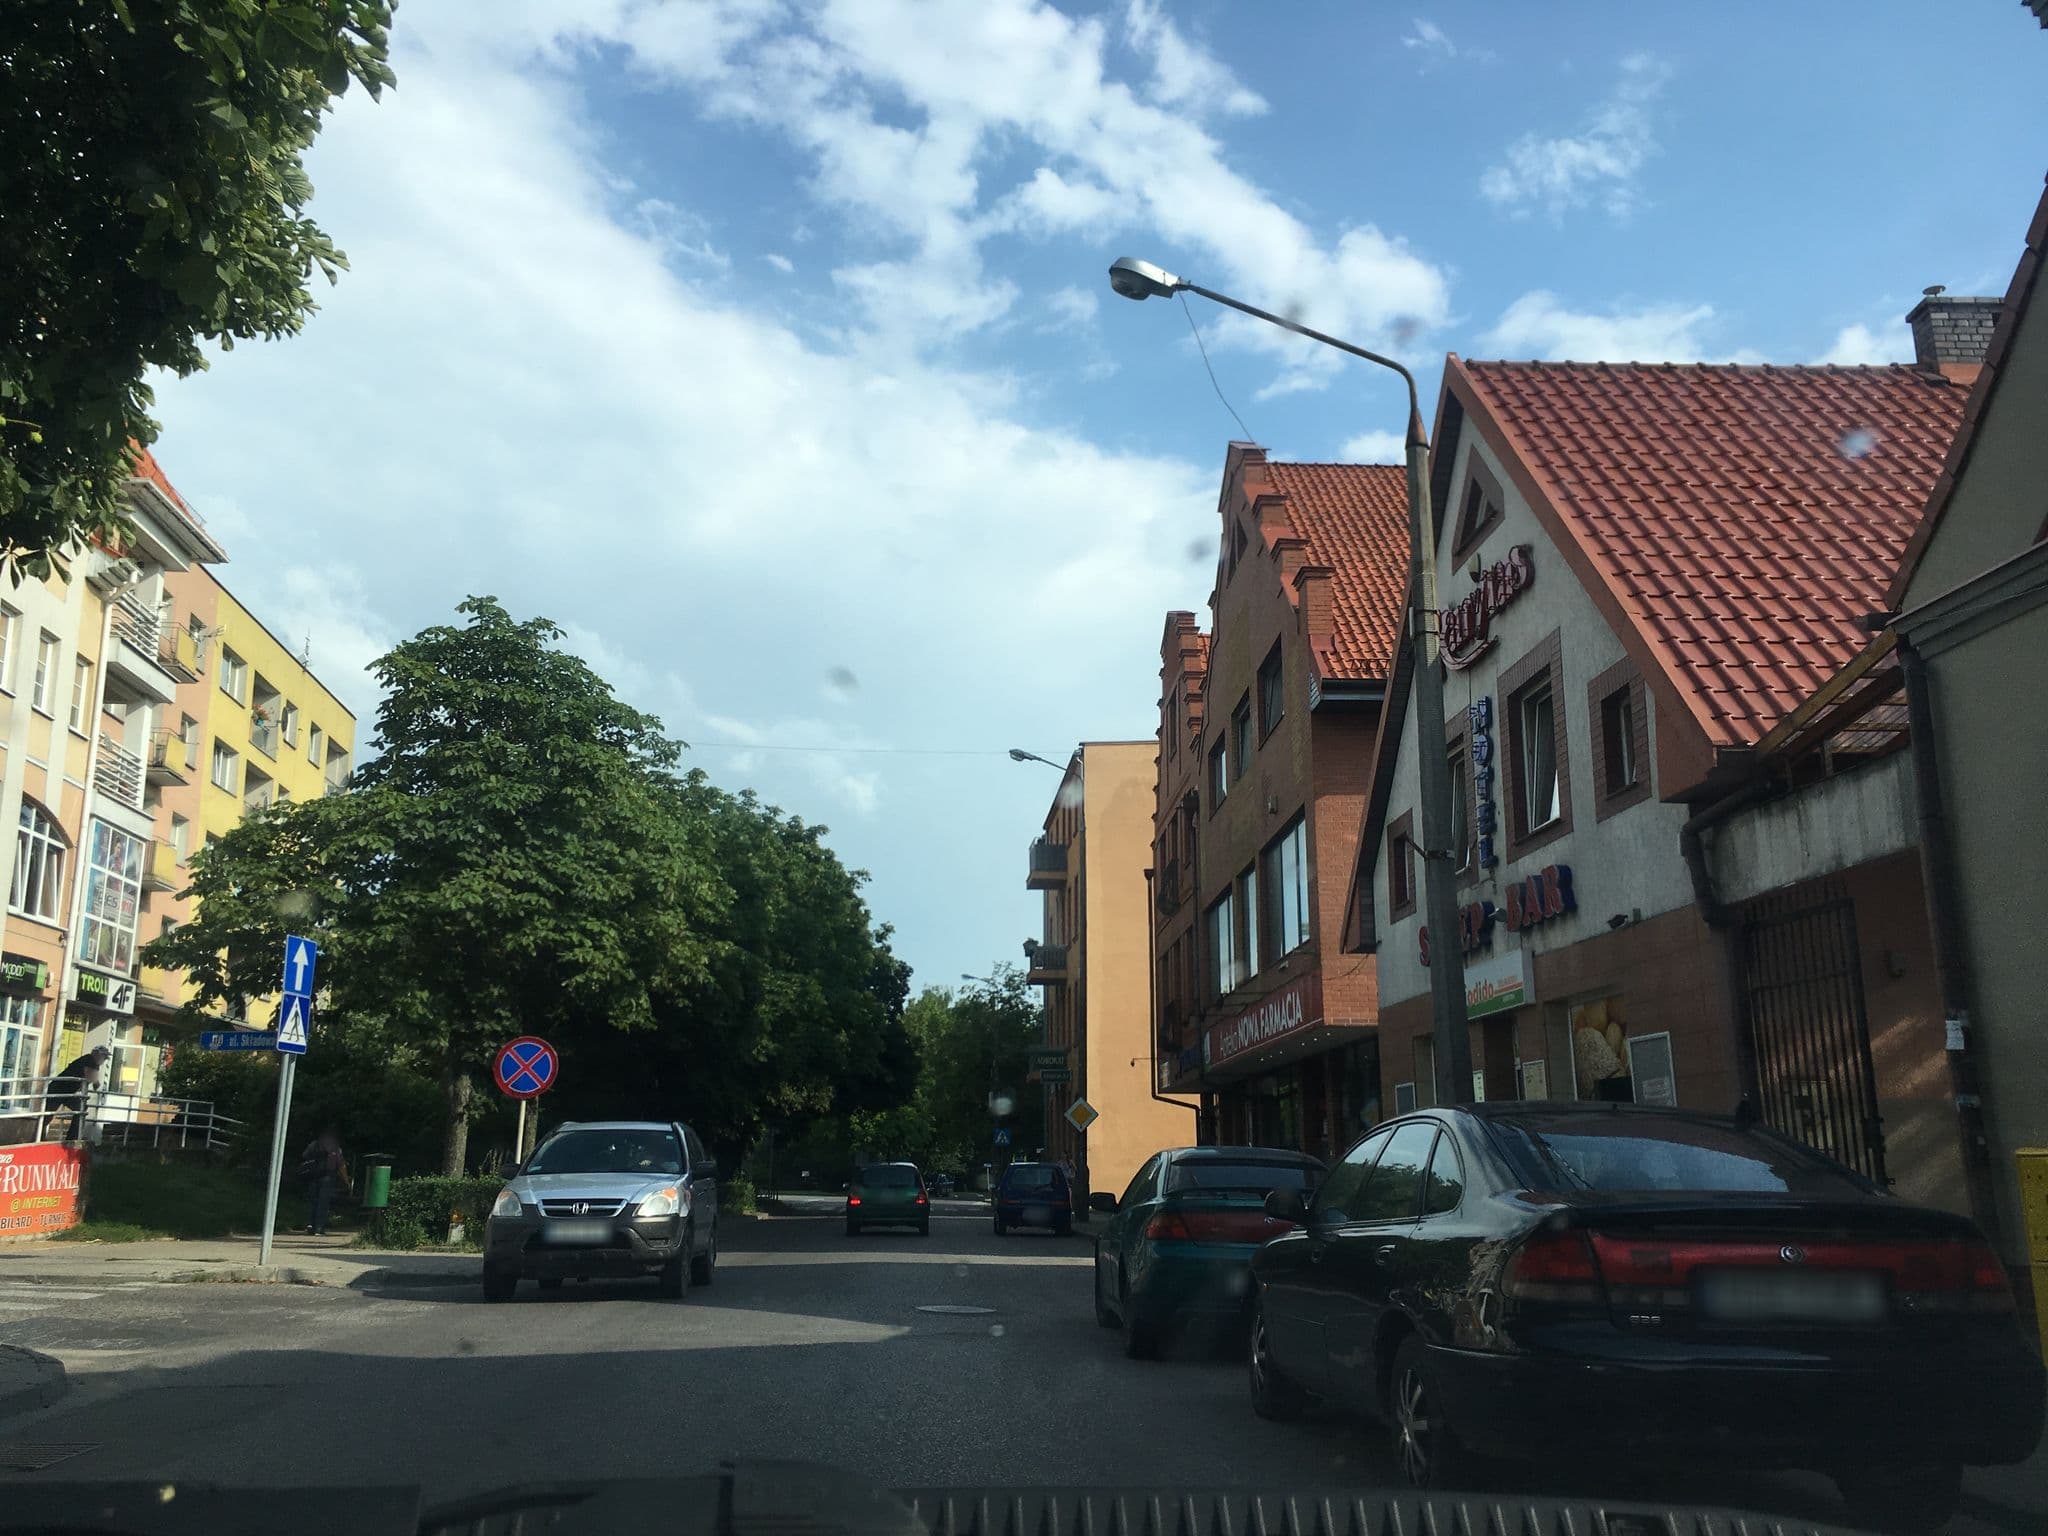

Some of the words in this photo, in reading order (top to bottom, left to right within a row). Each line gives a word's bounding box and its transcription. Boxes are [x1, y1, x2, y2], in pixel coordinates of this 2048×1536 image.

[1505, 864, 1577, 932] BAR
[81, 974, 109, 996] TROLL
[112, 983, 134, 1010] 4F
[1238, 1011, 1260, 1049] NOWA
[1260, 985, 1303, 1040] FARMACJA
[0, 1215, 33, 1230] BILARD
